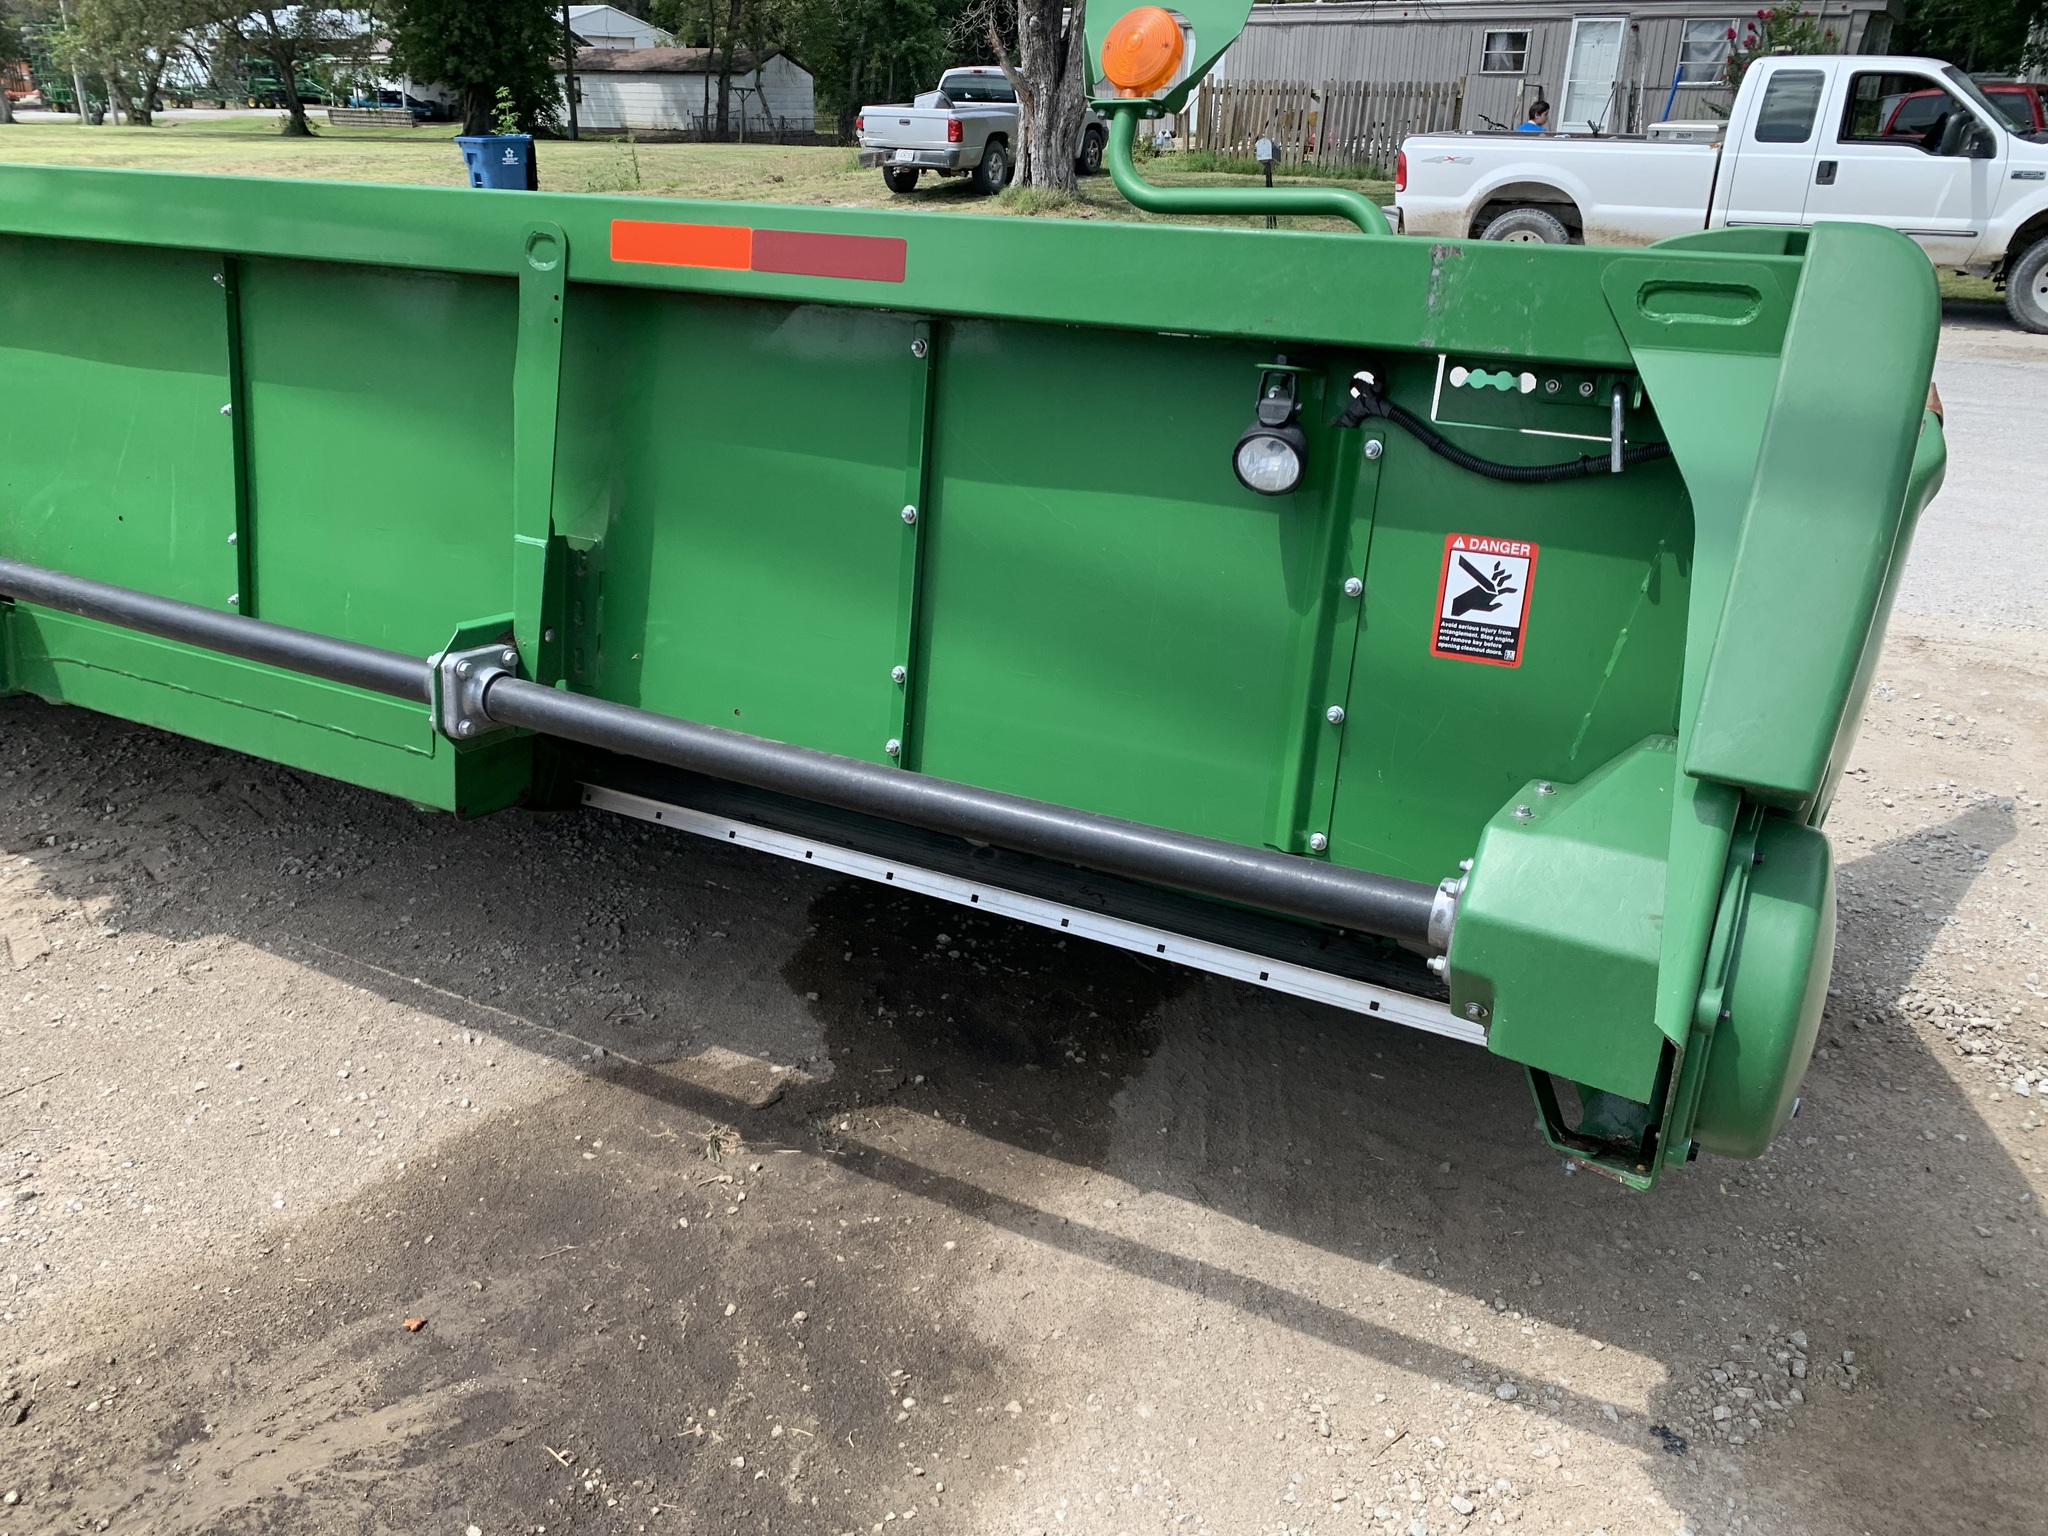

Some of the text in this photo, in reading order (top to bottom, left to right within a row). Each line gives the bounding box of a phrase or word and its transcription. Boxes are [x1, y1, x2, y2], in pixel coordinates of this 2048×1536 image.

[1469, 538, 1531, 556] DANGER
[1440, 621, 1458, 629] Avoid
[1458, 623, 1479, 631] serious
[1480, 626, 1497, 635] injury
[1439, 628, 1515, 644] entanglement. Stop engine
[1437, 642, 1503, 656] opening cleanout doors.
[1472, 639, 1483, 647] key
[1483, 641, 1503, 649] before
